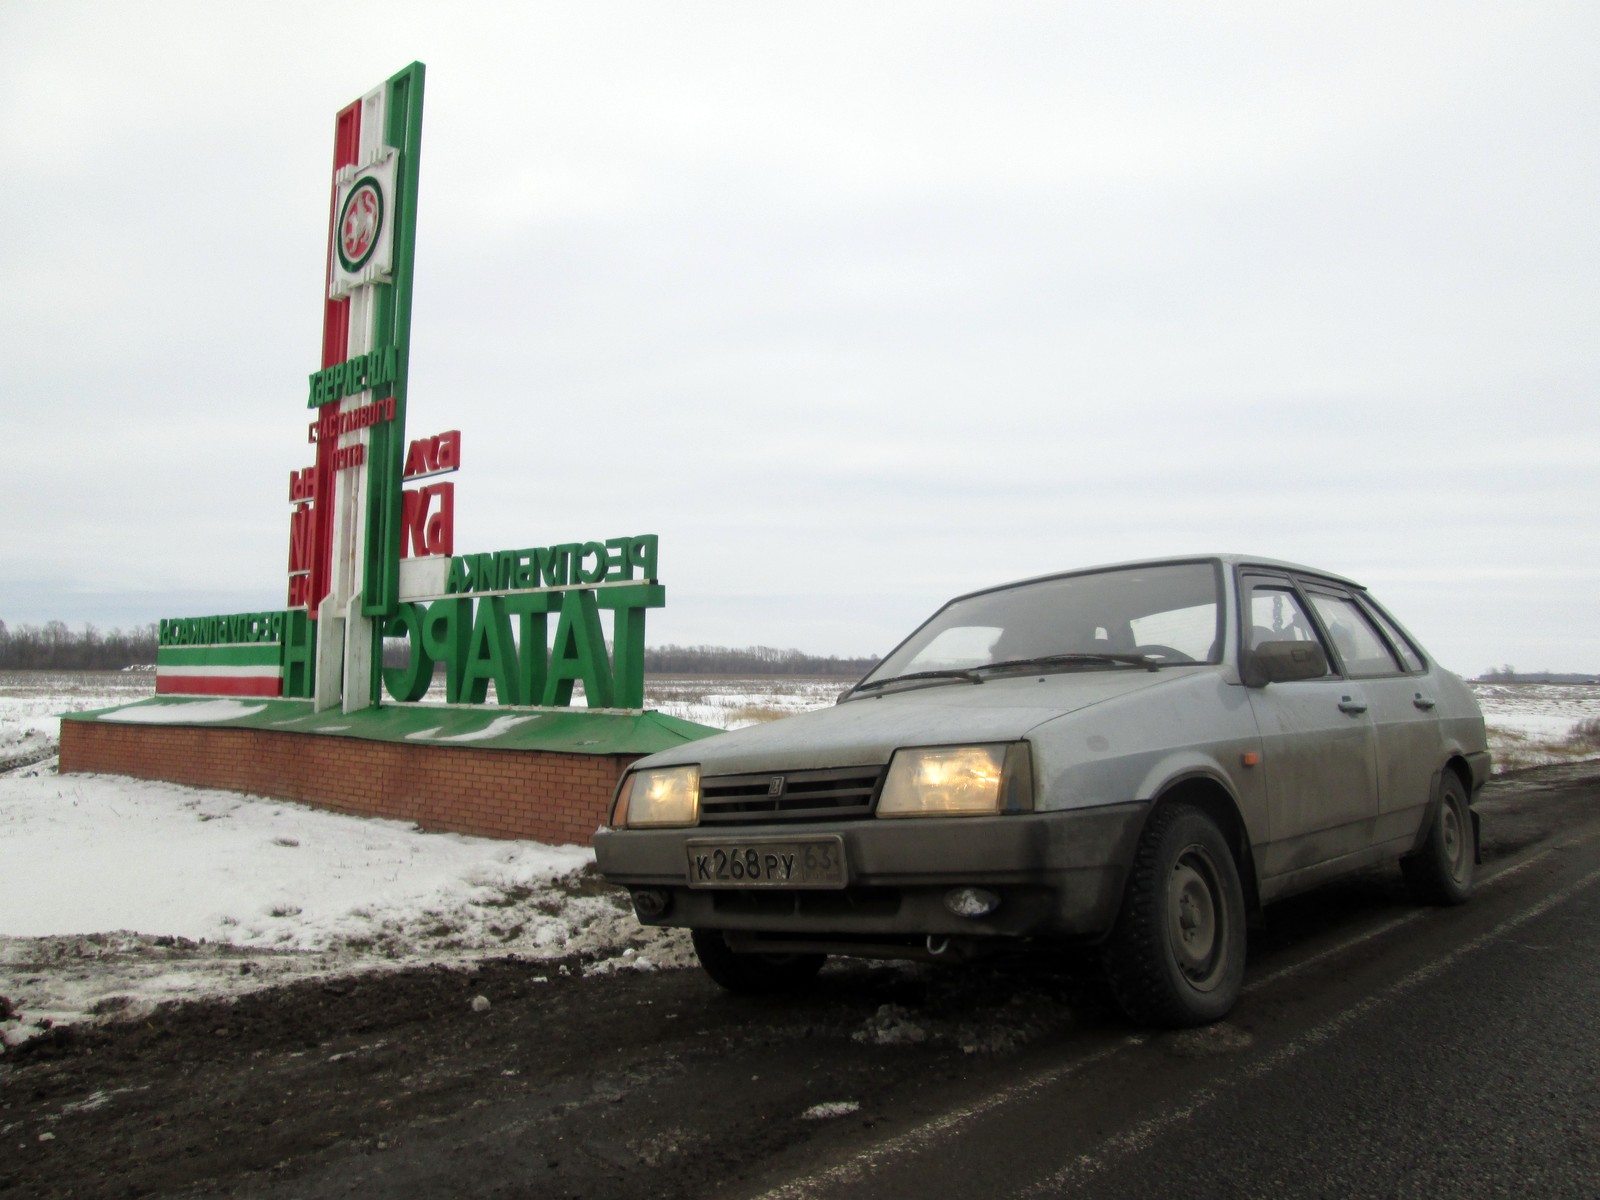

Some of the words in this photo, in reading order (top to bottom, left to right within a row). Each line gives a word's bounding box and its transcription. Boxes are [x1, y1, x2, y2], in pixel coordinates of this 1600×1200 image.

[308, 397, 396, 443] СЧАСТЛИВОГО
[330, 443, 364, 472] ПУТИ
[804, 846, 832, 870] 63
